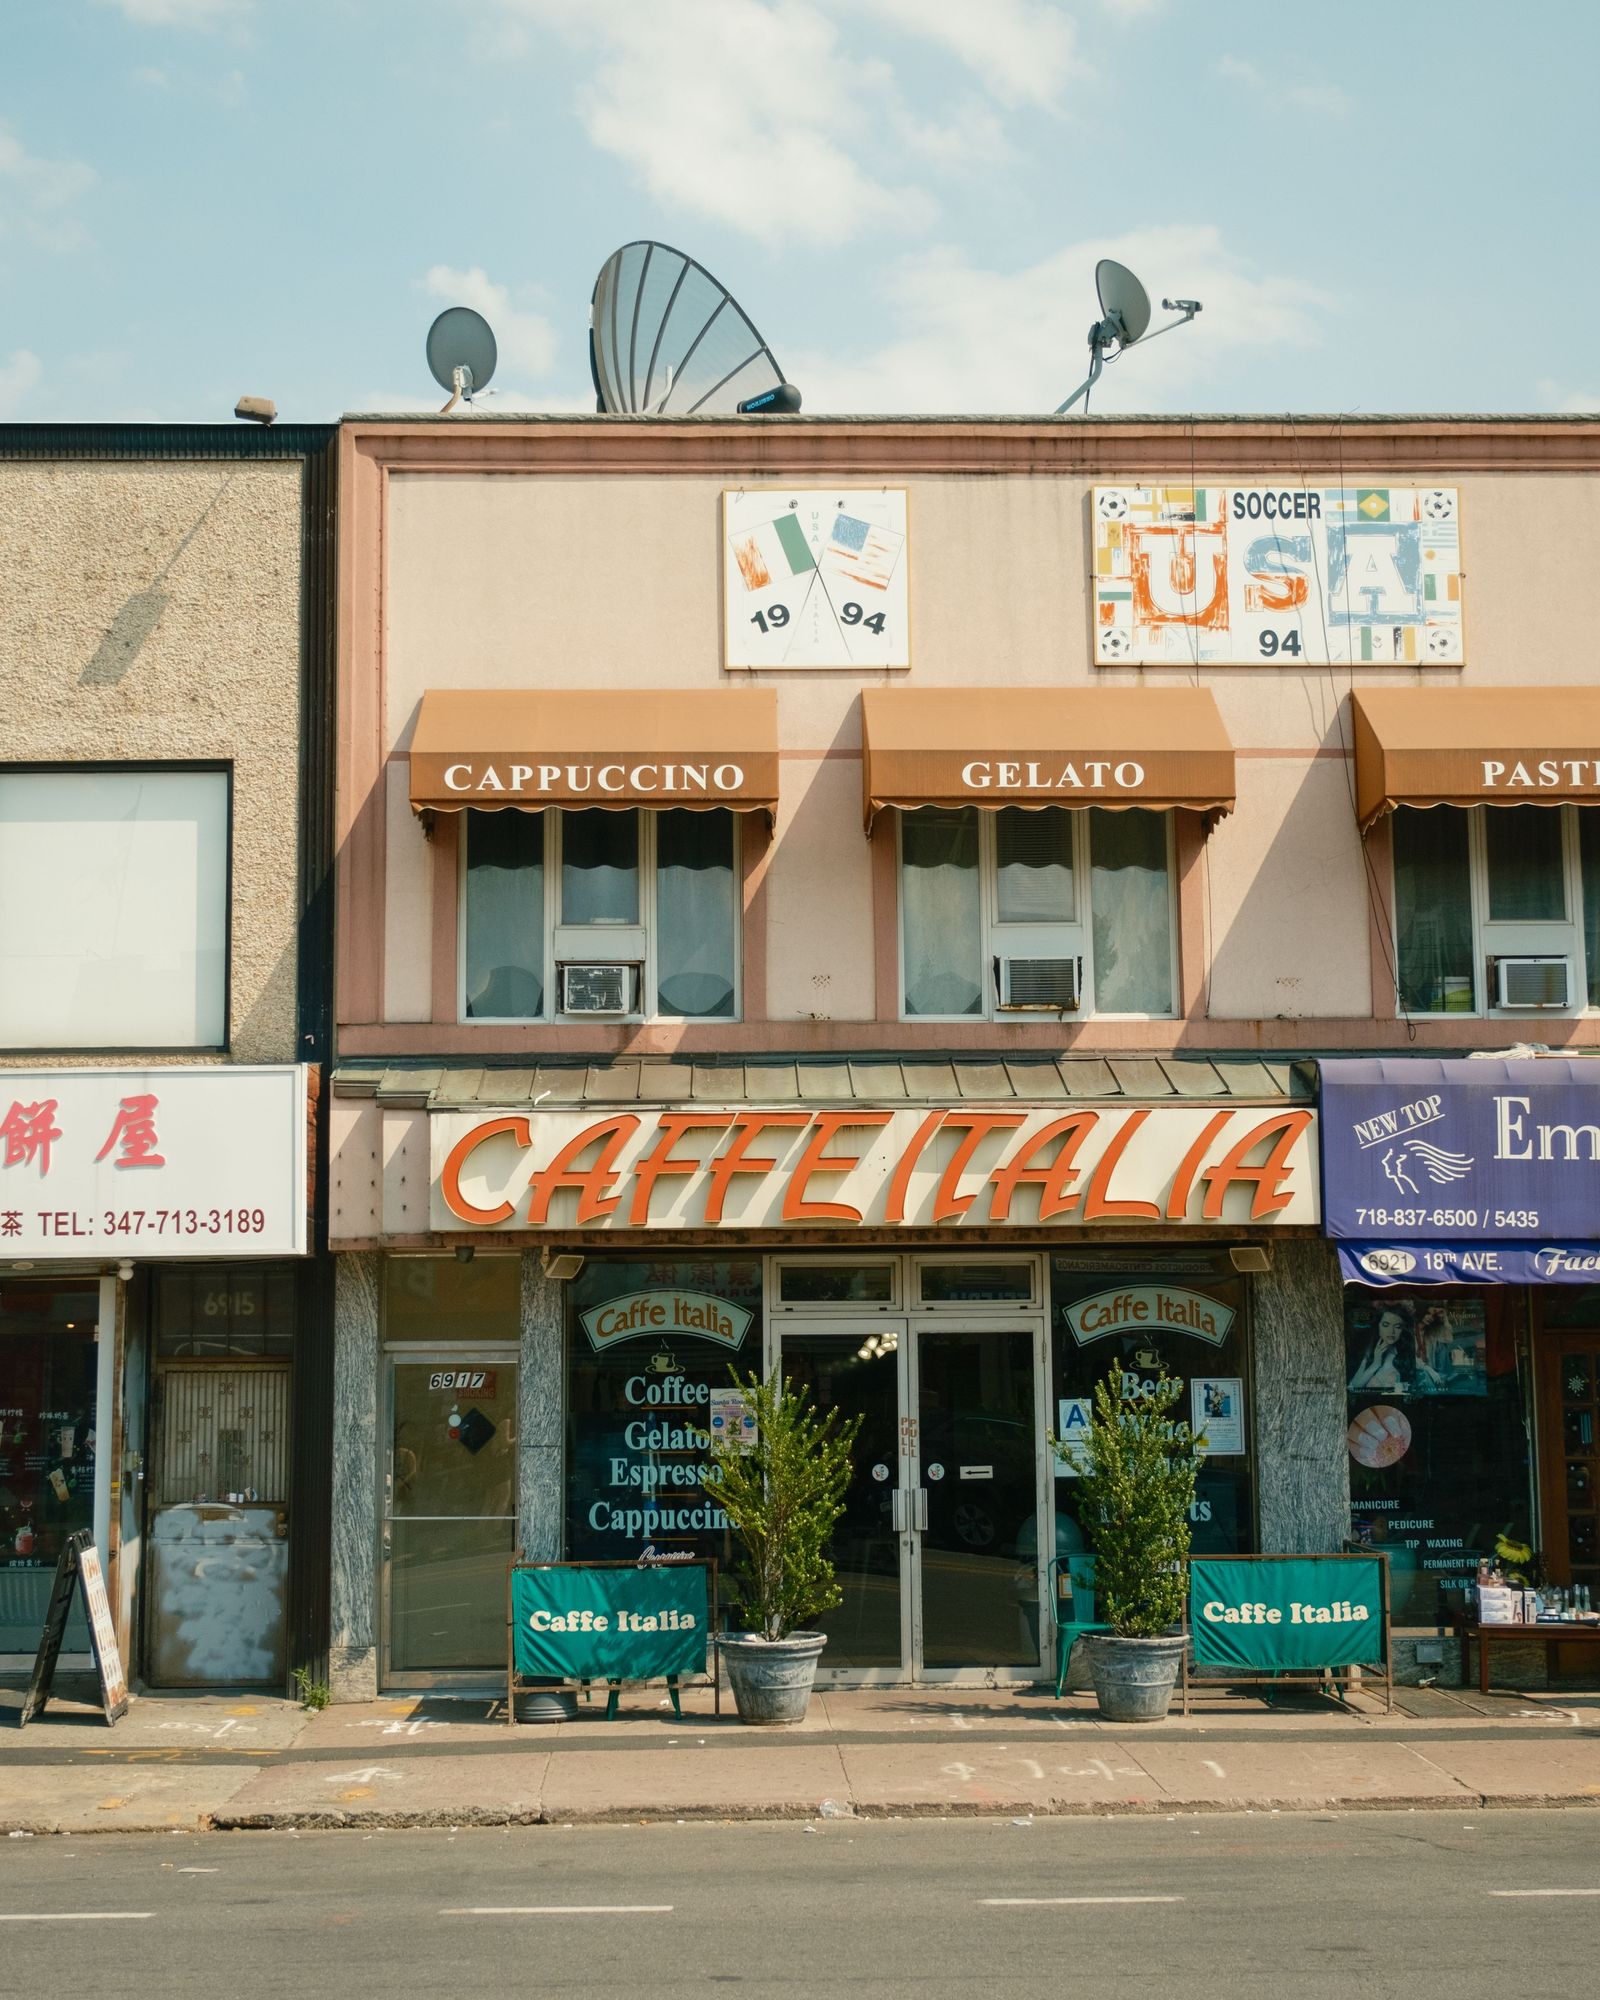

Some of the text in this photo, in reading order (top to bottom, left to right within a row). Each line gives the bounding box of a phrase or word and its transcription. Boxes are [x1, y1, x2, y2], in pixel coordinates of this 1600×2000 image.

[1233, 492, 1321, 520] SOCCER
[811, 511, 819, 542] USA
[1137, 529, 1420, 618] USA
[1259, 629, 1302, 657] 94
[443, 764, 745, 792] CAPPUCCINO
[961, 762, 1145, 788] GELATO
[1352, 1094, 1442, 1145] NEW TOP
[38, 1211, 94, 1236] TEL:
[103, 1208, 265, 1236] 347-713-3189
[1356, 1208, 1478, 1227] 718-837-6500
[1495, 1210, 1539, 1228] 5435
[1368, 1254, 1410, 1271] 6921
[1462, 1253, 1503, 1271] AVE.
[204, 1291, 255, 1316] 6915
[1080, 1293, 1218, 1337] Caffe Italia
[596, 1297, 735, 1341] Caffe Italia
[431, 1373, 485, 1388] 6917
[625, 1375, 709, 1405] Coffee
[1065, 1404, 1086, 1428] A
[624, 1421, 710, 1450] Gelato
[900, 1417, 908, 1456] PULL
[909, 1419, 917, 1458] PULL
[609, 1457, 724, 1494] Espresso
[1351, 1500, 1400, 1510] MANICURE
[1388, 1519, 1435, 1530] PEDICURE
[1405, 1538, 1463, 1549] TIP WAXING
[1423, 1559, 1465, 1569] PERMANENT
[1440, 1579, 1456, 1589] SILK
[529, 1609, 697, 1632] Caffe Italia
[1203, 1601, 1370, 1624] Caffe Italia
